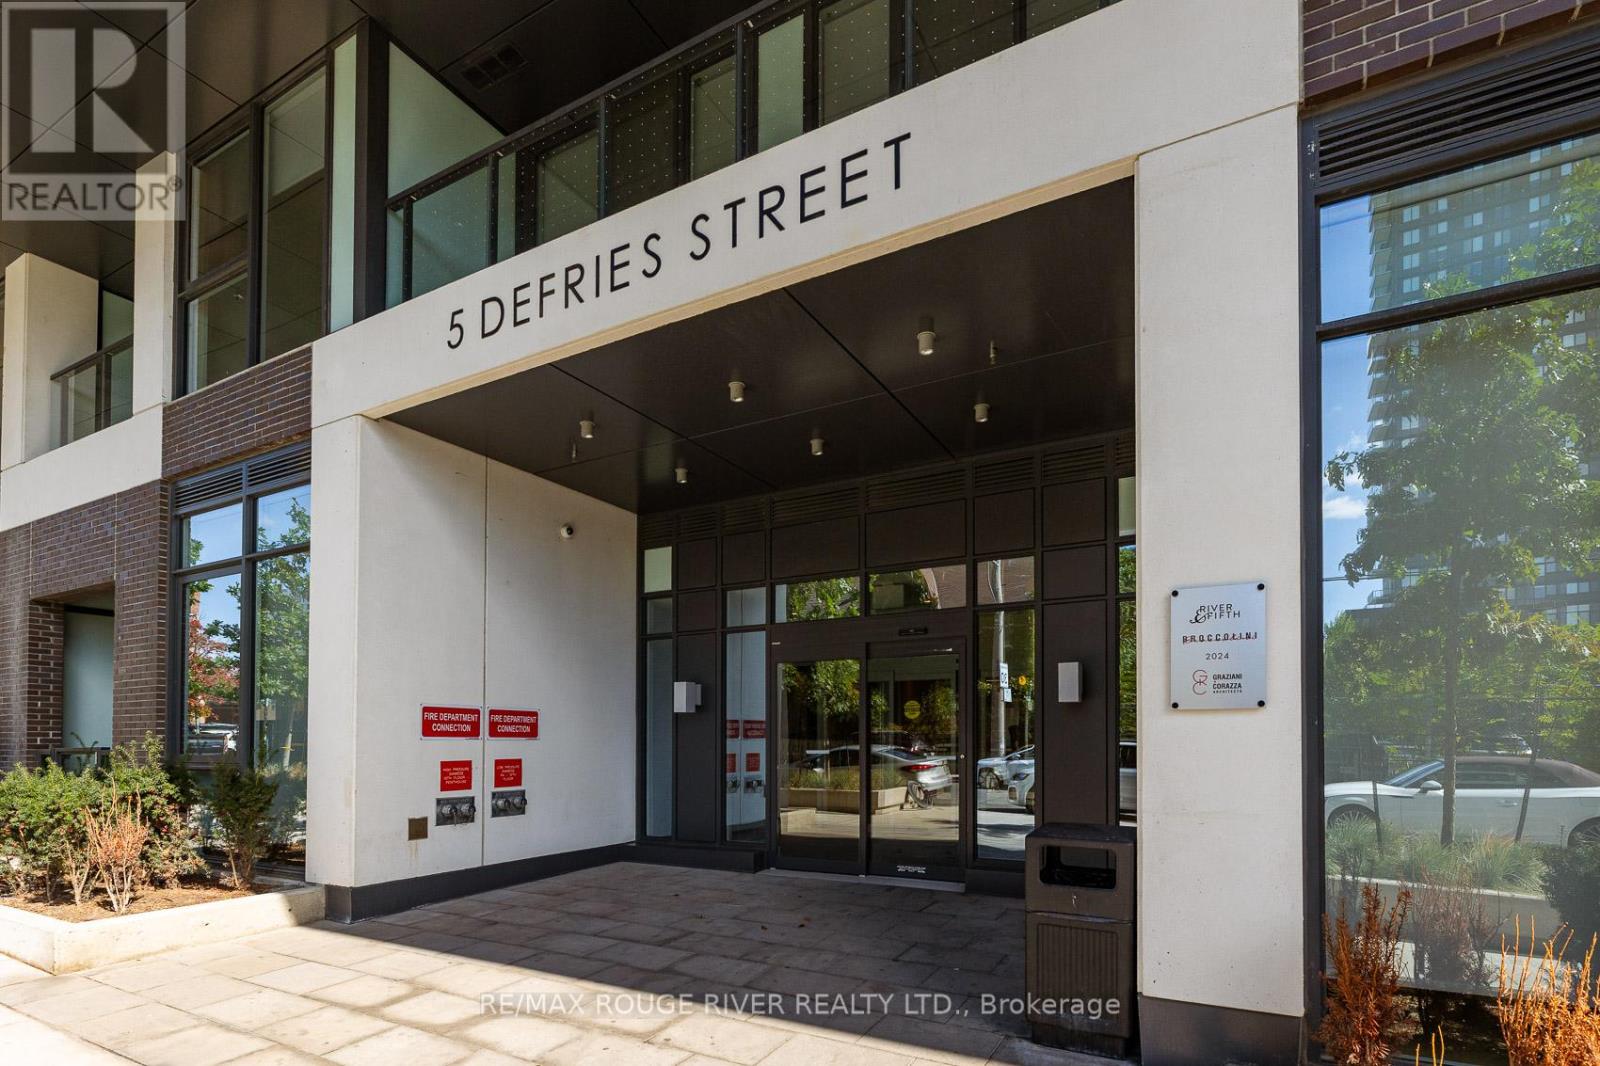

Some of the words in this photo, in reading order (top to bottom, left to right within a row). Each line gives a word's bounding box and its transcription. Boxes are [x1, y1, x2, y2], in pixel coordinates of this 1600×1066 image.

[446, 308, 465, 350] 5
[480, 232, 662, 340] DEFRIES
[689, 132, 912, 262] STREET
[1200, 603, 1233, 613] RIVER
[1207, 610, 1241, 620] FIFTH
[1182, 631, 1258, 645] BROCCOLINI
[1205, 652, 1230, 661] 2024
[1212, 673, 1243, 681] GRAZIANI
[1212, 682, 1243, 690] CORAZZA
[424, 712, 438, 721] FIRE
[439, 712, 479, 722] DEPARTMENT
[490, 714, 502, 722] FIRE
[502, 715, 537, 724] DEPARTMENT
[431, 723, 472, 732] CONNECTION
[496, 724, 531, 733] CONNECTION
